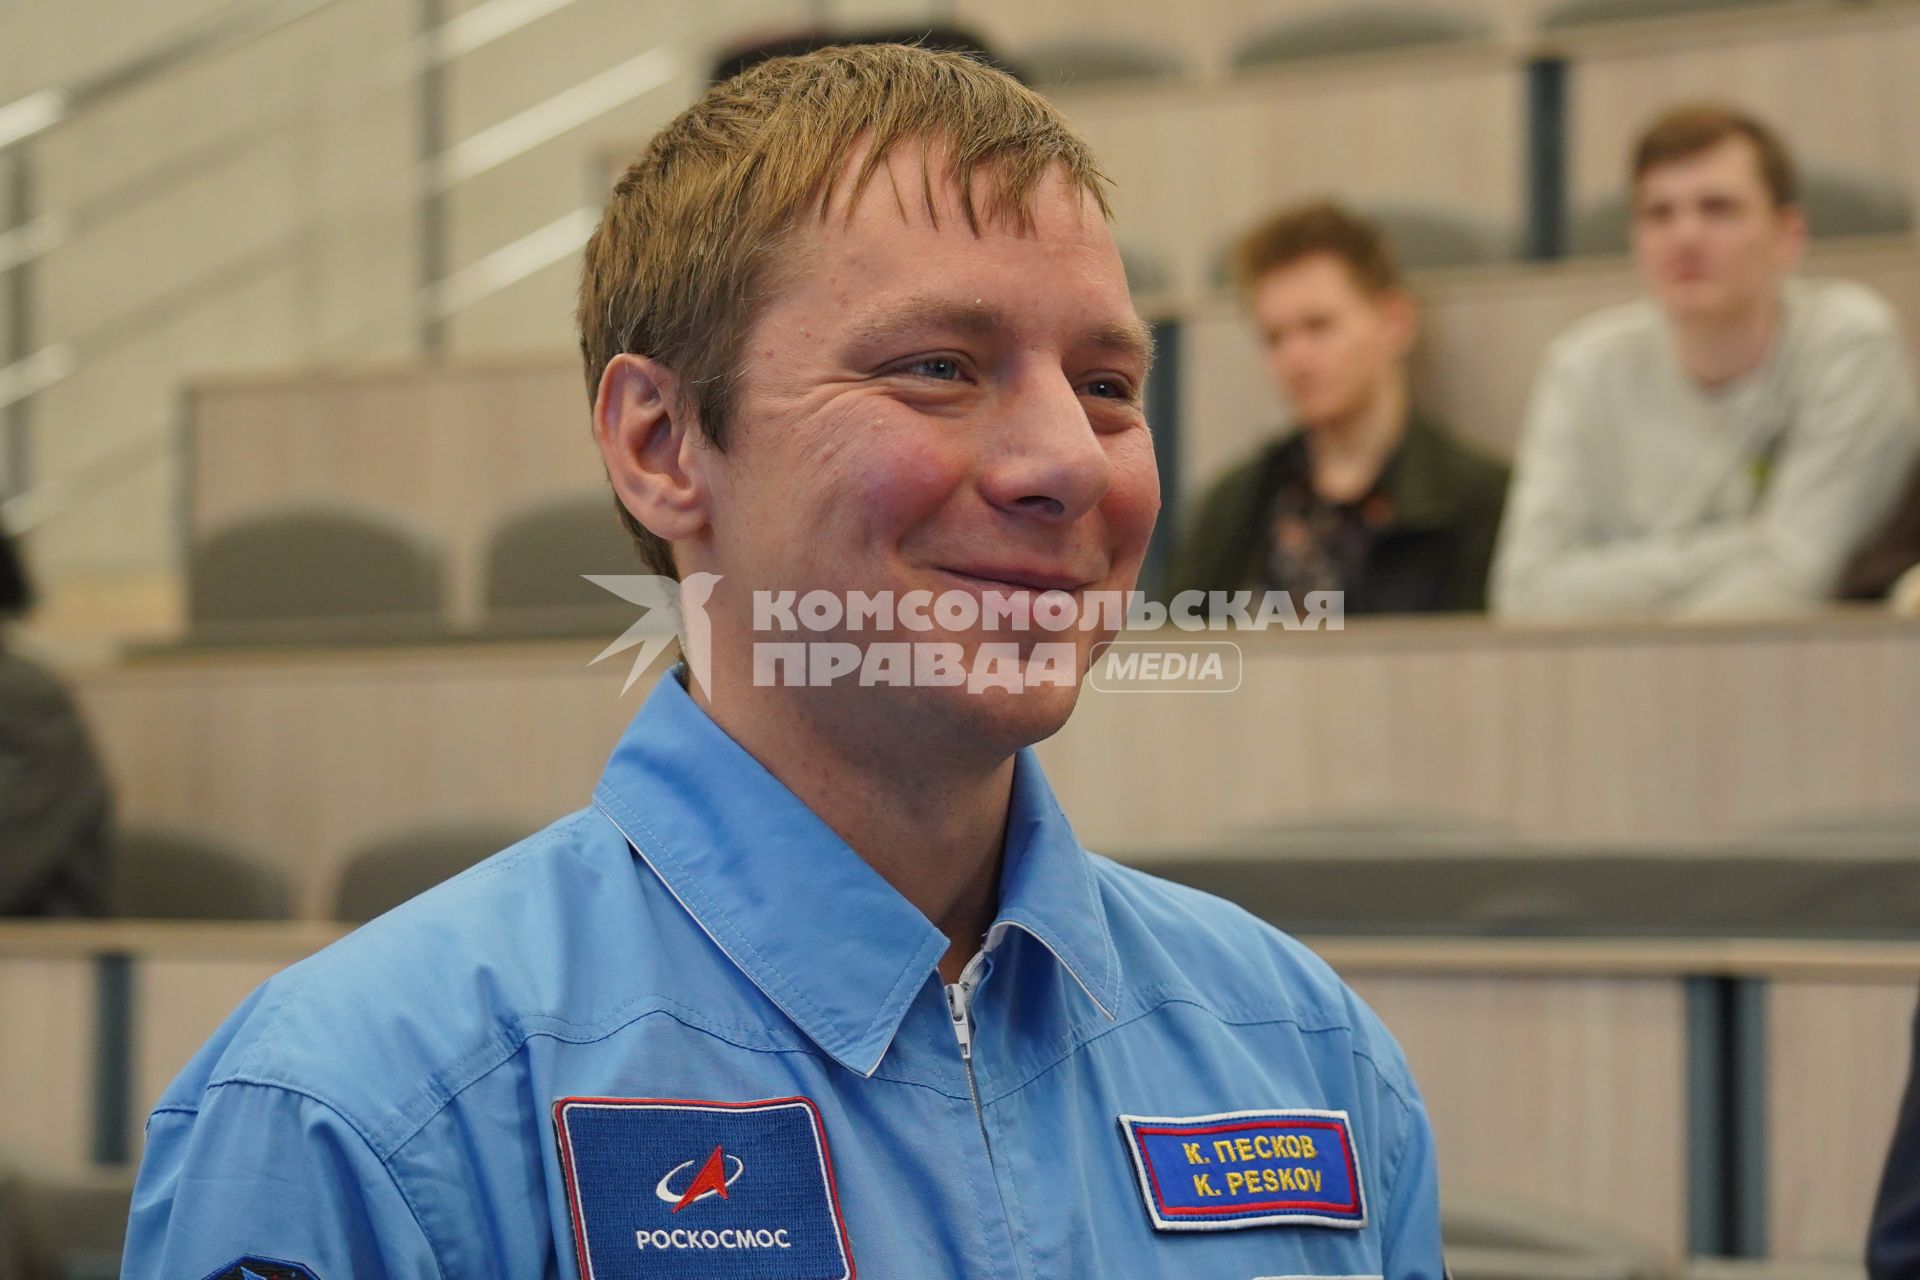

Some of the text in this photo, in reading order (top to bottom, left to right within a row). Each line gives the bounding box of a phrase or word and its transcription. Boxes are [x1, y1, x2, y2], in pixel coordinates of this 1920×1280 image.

[1182, 1135, 1318, 1165] К. ПЕСКОВ
[1193, 1167, 1322, 1197] K. PESKOV
[636, 1228, 791, 1250] РОСКОСМОС
